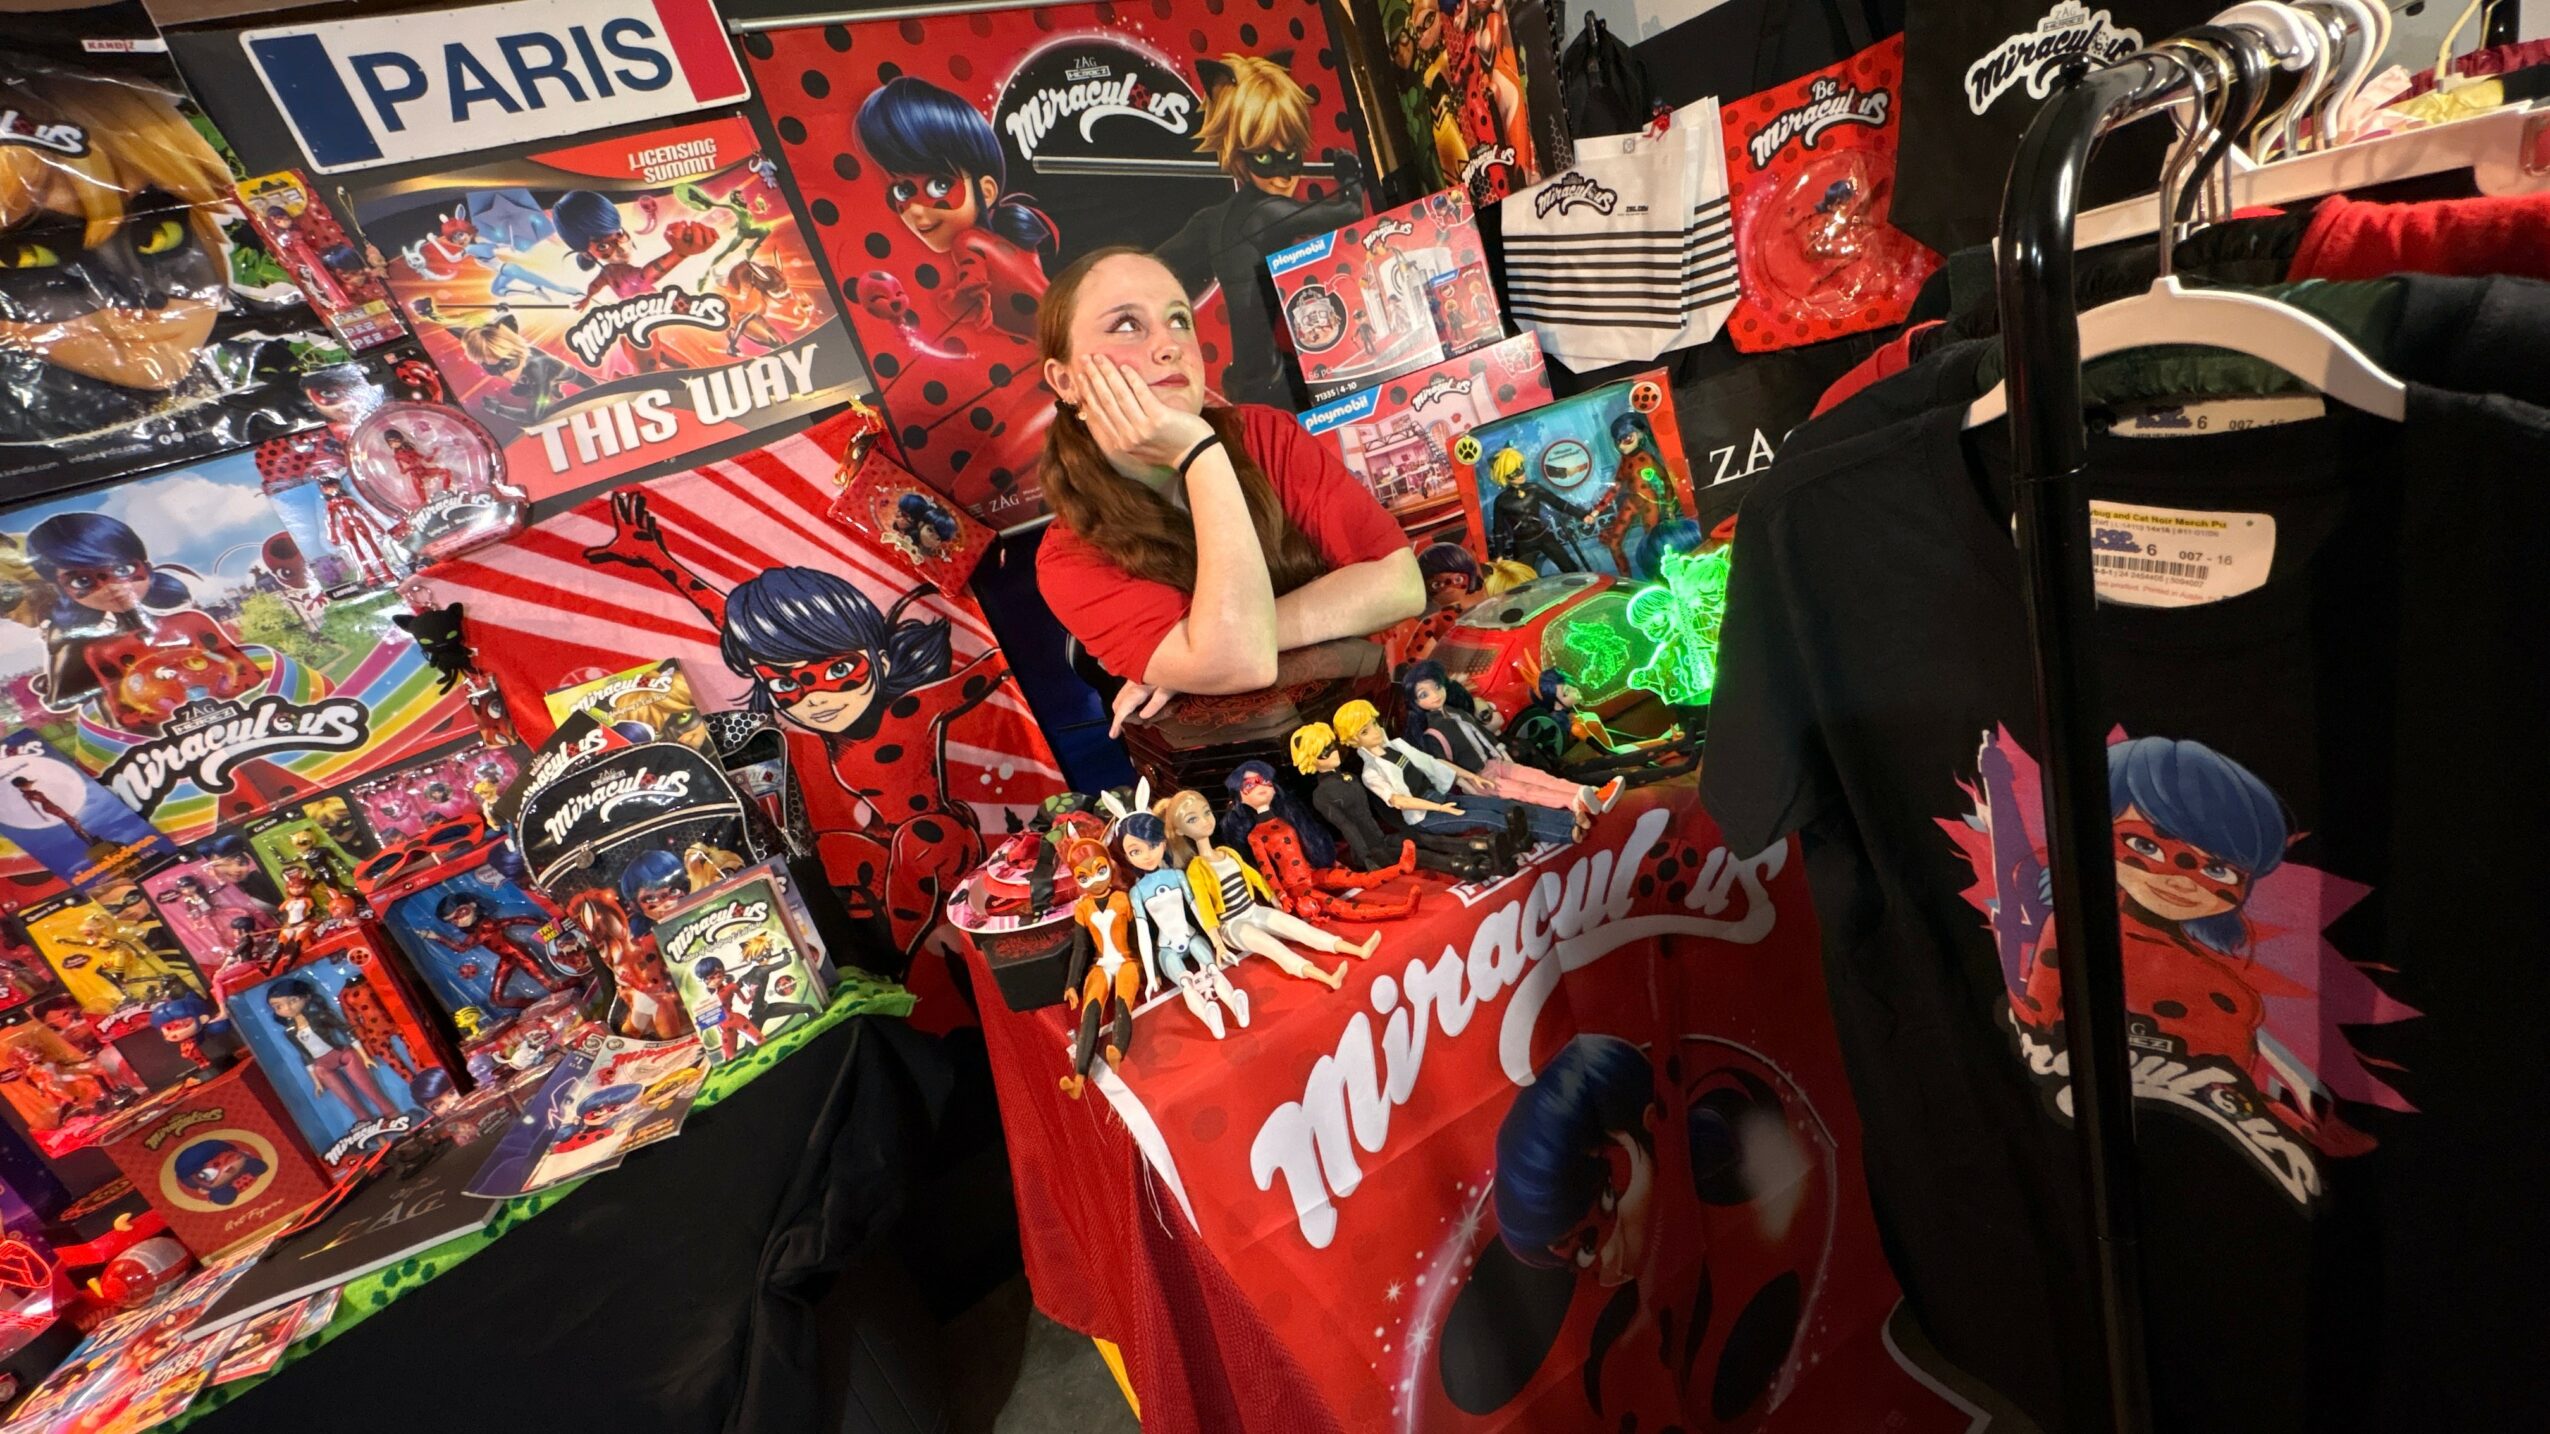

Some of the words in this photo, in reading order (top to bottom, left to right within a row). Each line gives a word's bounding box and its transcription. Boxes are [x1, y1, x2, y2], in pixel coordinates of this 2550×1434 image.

[348, 16, 675, 133] PARIS
[1812, 80, 1836, 100] Be
[628, 138, 718, 172] LICENSING
[643, 153, 718, 184] SUMMIT
[1271, 240, 1326, 271] playmobil
[1340, 382, 1358, 394] 4-10
[531, 387, 679, 473] THIS
[690, 344, 818, 425] WAY
[1305, 395, 1369, 431] playmobil
[2197, 415, 2208, 430] 6
[1699, 427, 1794, 490] ZA
[989, 494, 1019, 513] ZAG
[2112, 511, 2131, 521] and
[2132, 512, 2150, 522] Cat
[2146, 543, 2158, 557] 6
[2178, 550, 2204, 562] 007
[181, 702, 218, 721] ZAG
